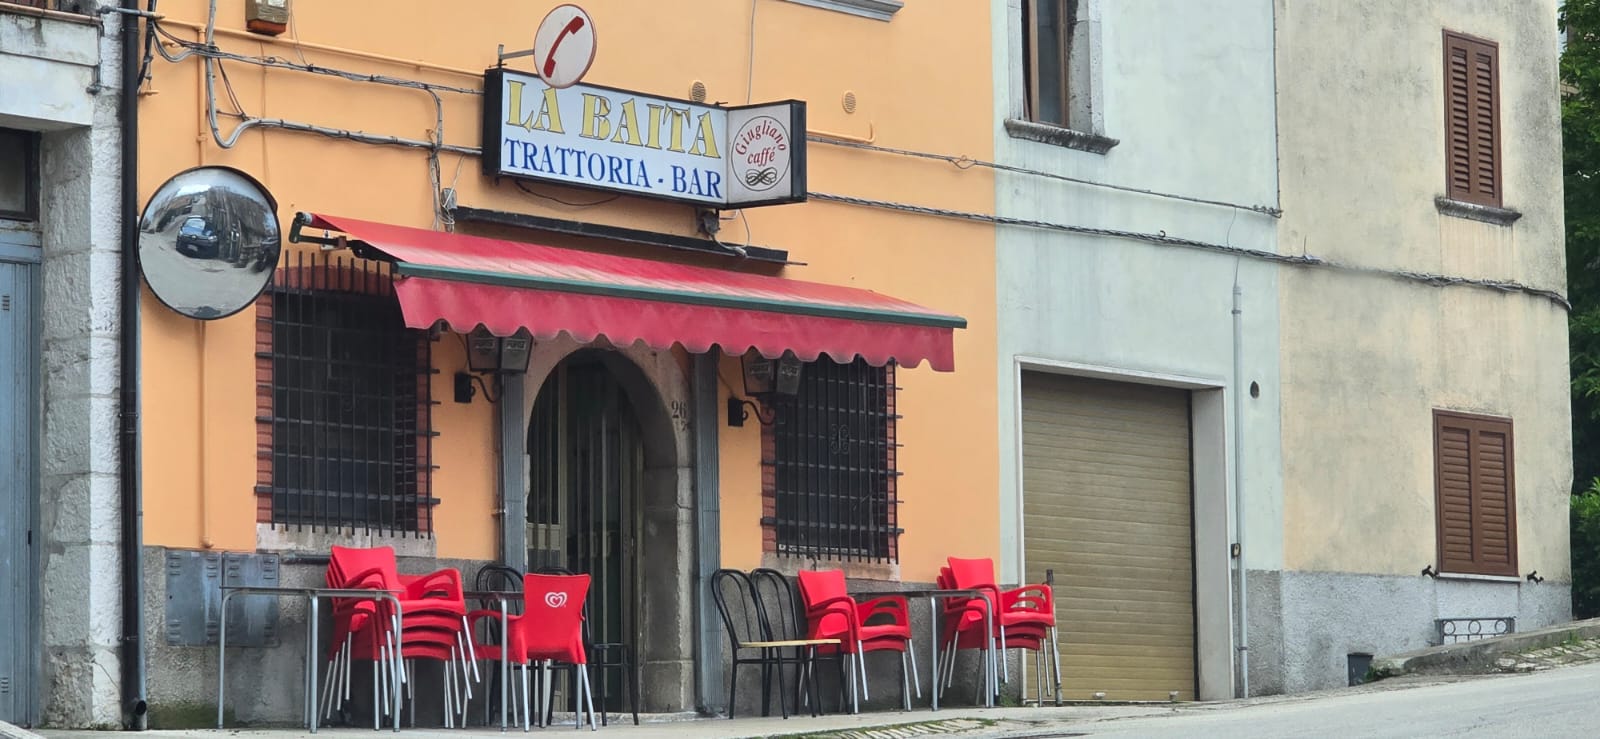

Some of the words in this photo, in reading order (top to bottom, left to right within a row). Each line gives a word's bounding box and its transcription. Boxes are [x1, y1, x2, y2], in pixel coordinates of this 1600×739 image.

[506, 79, 565, 134] LA
[579, 92, 721, 159] BAITA
[735, 120, 787, 155] Giugliano
[504, 137, 653, 188] TRATTORIA
[671, 165, 722, 199] BAR
[747, 146, 776, 167] caffé
